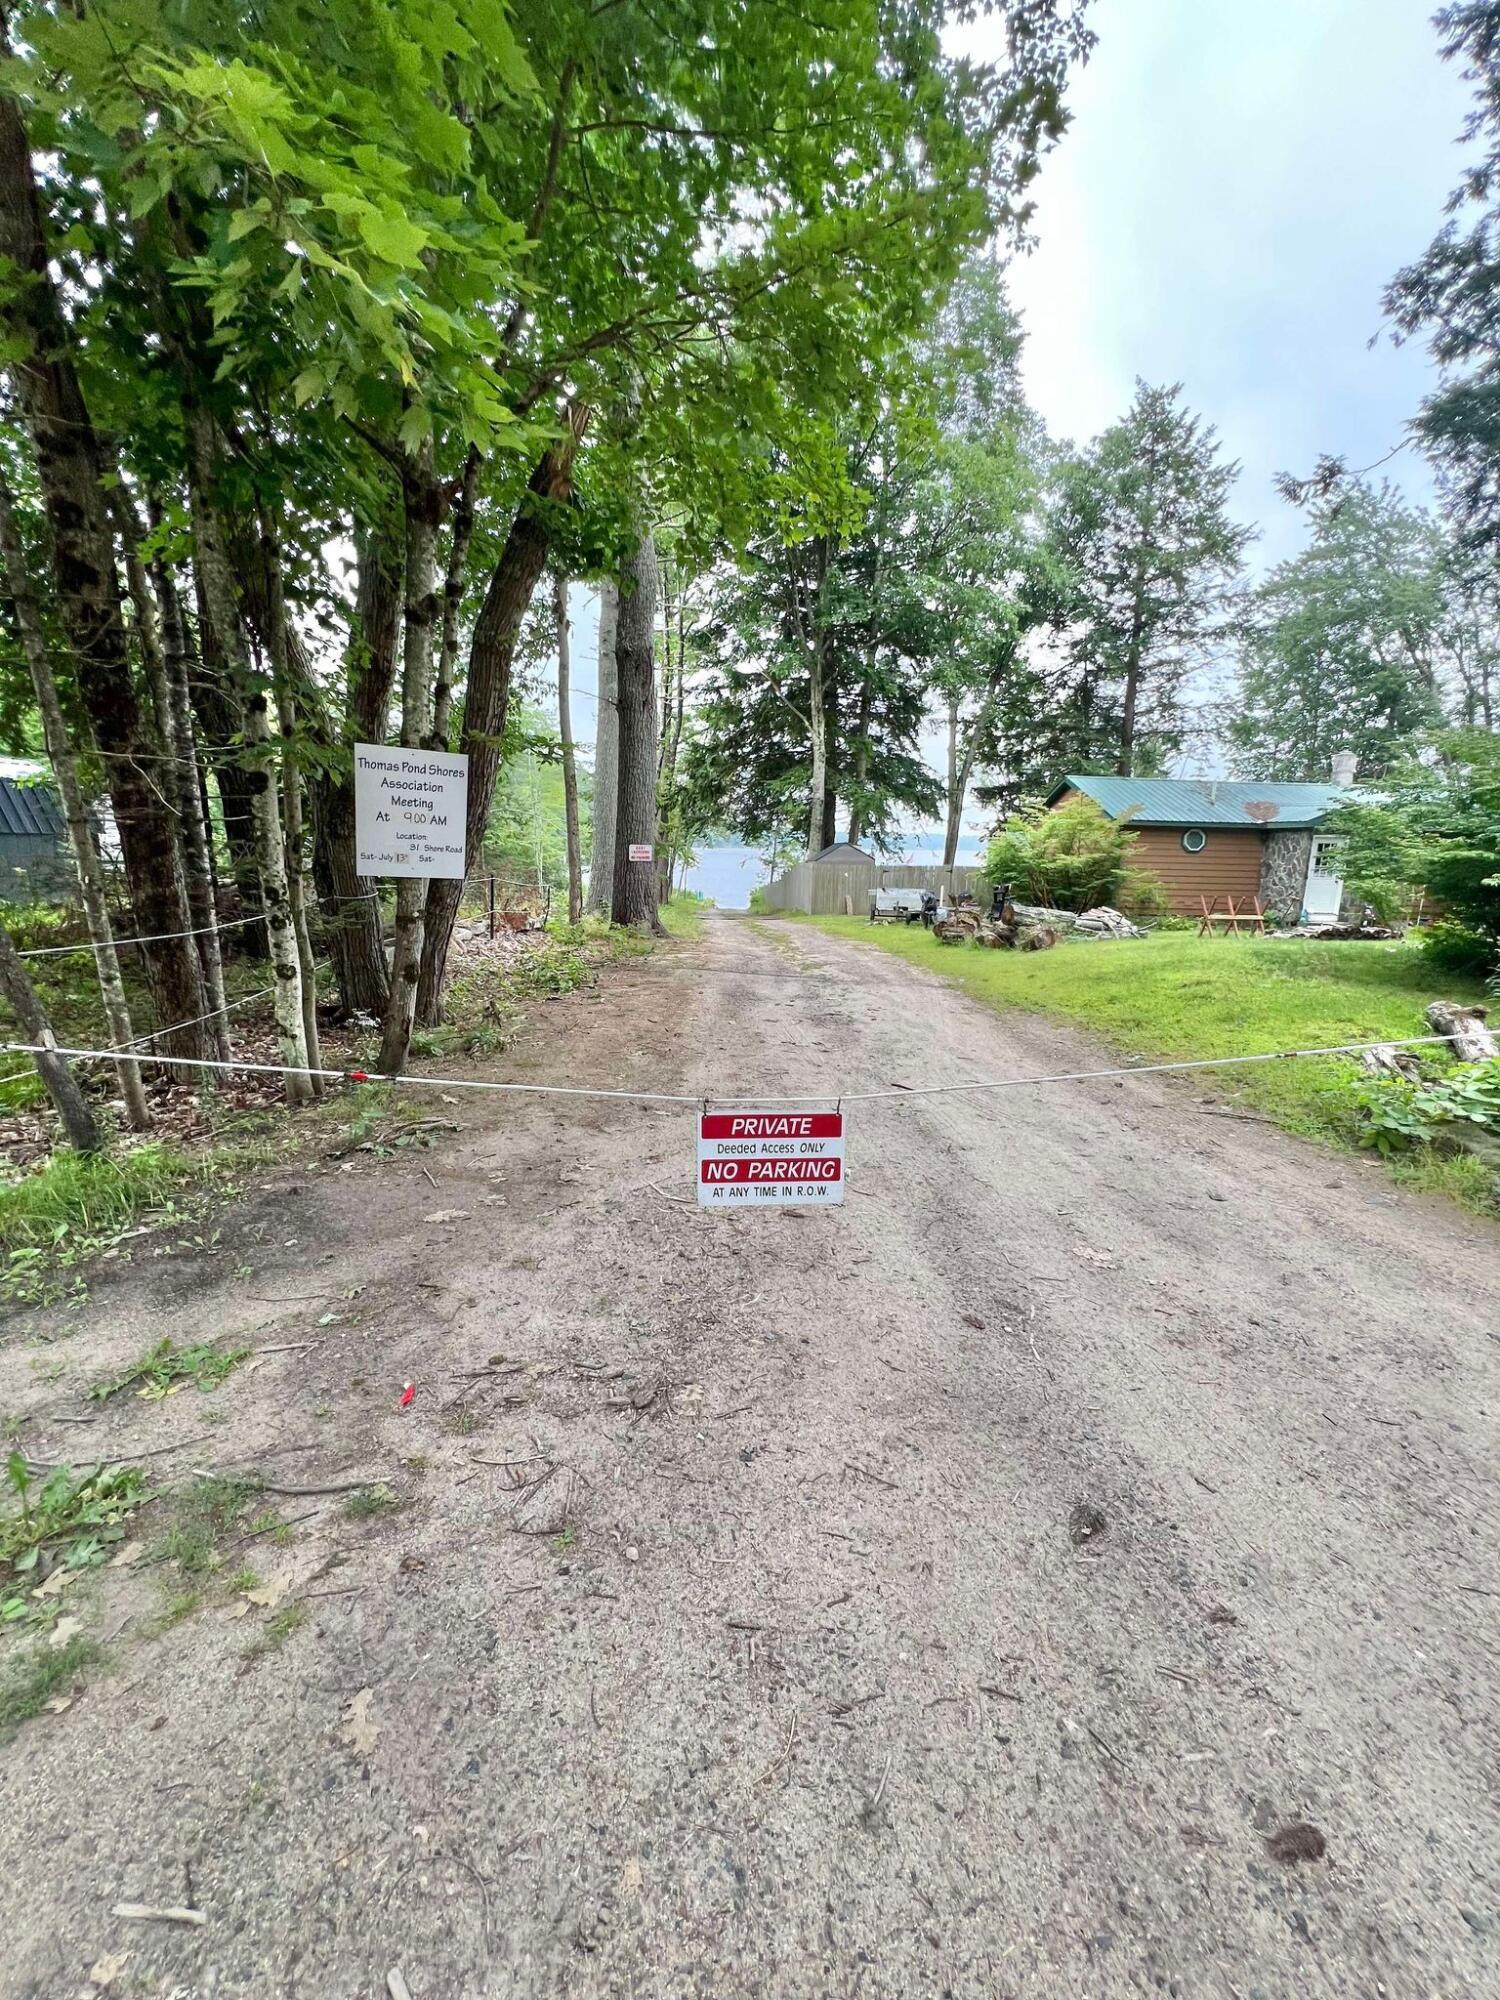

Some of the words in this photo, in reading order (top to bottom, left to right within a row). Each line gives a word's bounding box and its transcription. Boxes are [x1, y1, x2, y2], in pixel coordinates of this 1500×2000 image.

[358, 758, 399, 772] Thomas
[402, 762, 426, 774] Pond
[429, 765, 465, 778] Shores
[381, 777, 443, 792] Association
[392, 796, 433, 811] Meeting
[376, 811, 390, 822] At
[430, 816, 446, 826] AM
[379, 853, 393, 862] July
[731, 1118, 812, 1135] PRIVATE
[717, 1144, 756, 1154] Deeded
[761, 1143, 794, 1153] Access
[800, 1143, 826, 1153] ONLY
[707, 1162, 738, 1180] NO
[748, 1161, 836, 1178] PARKING
[712, 1188, 724, 1197] AT
[729, 1187, 749, 1197] ANY
[754, 1187, 776, 1196] TIME
[782, 1187, 792, 1196] IN
[797, 1186, 829, 1196] R.O.W.
